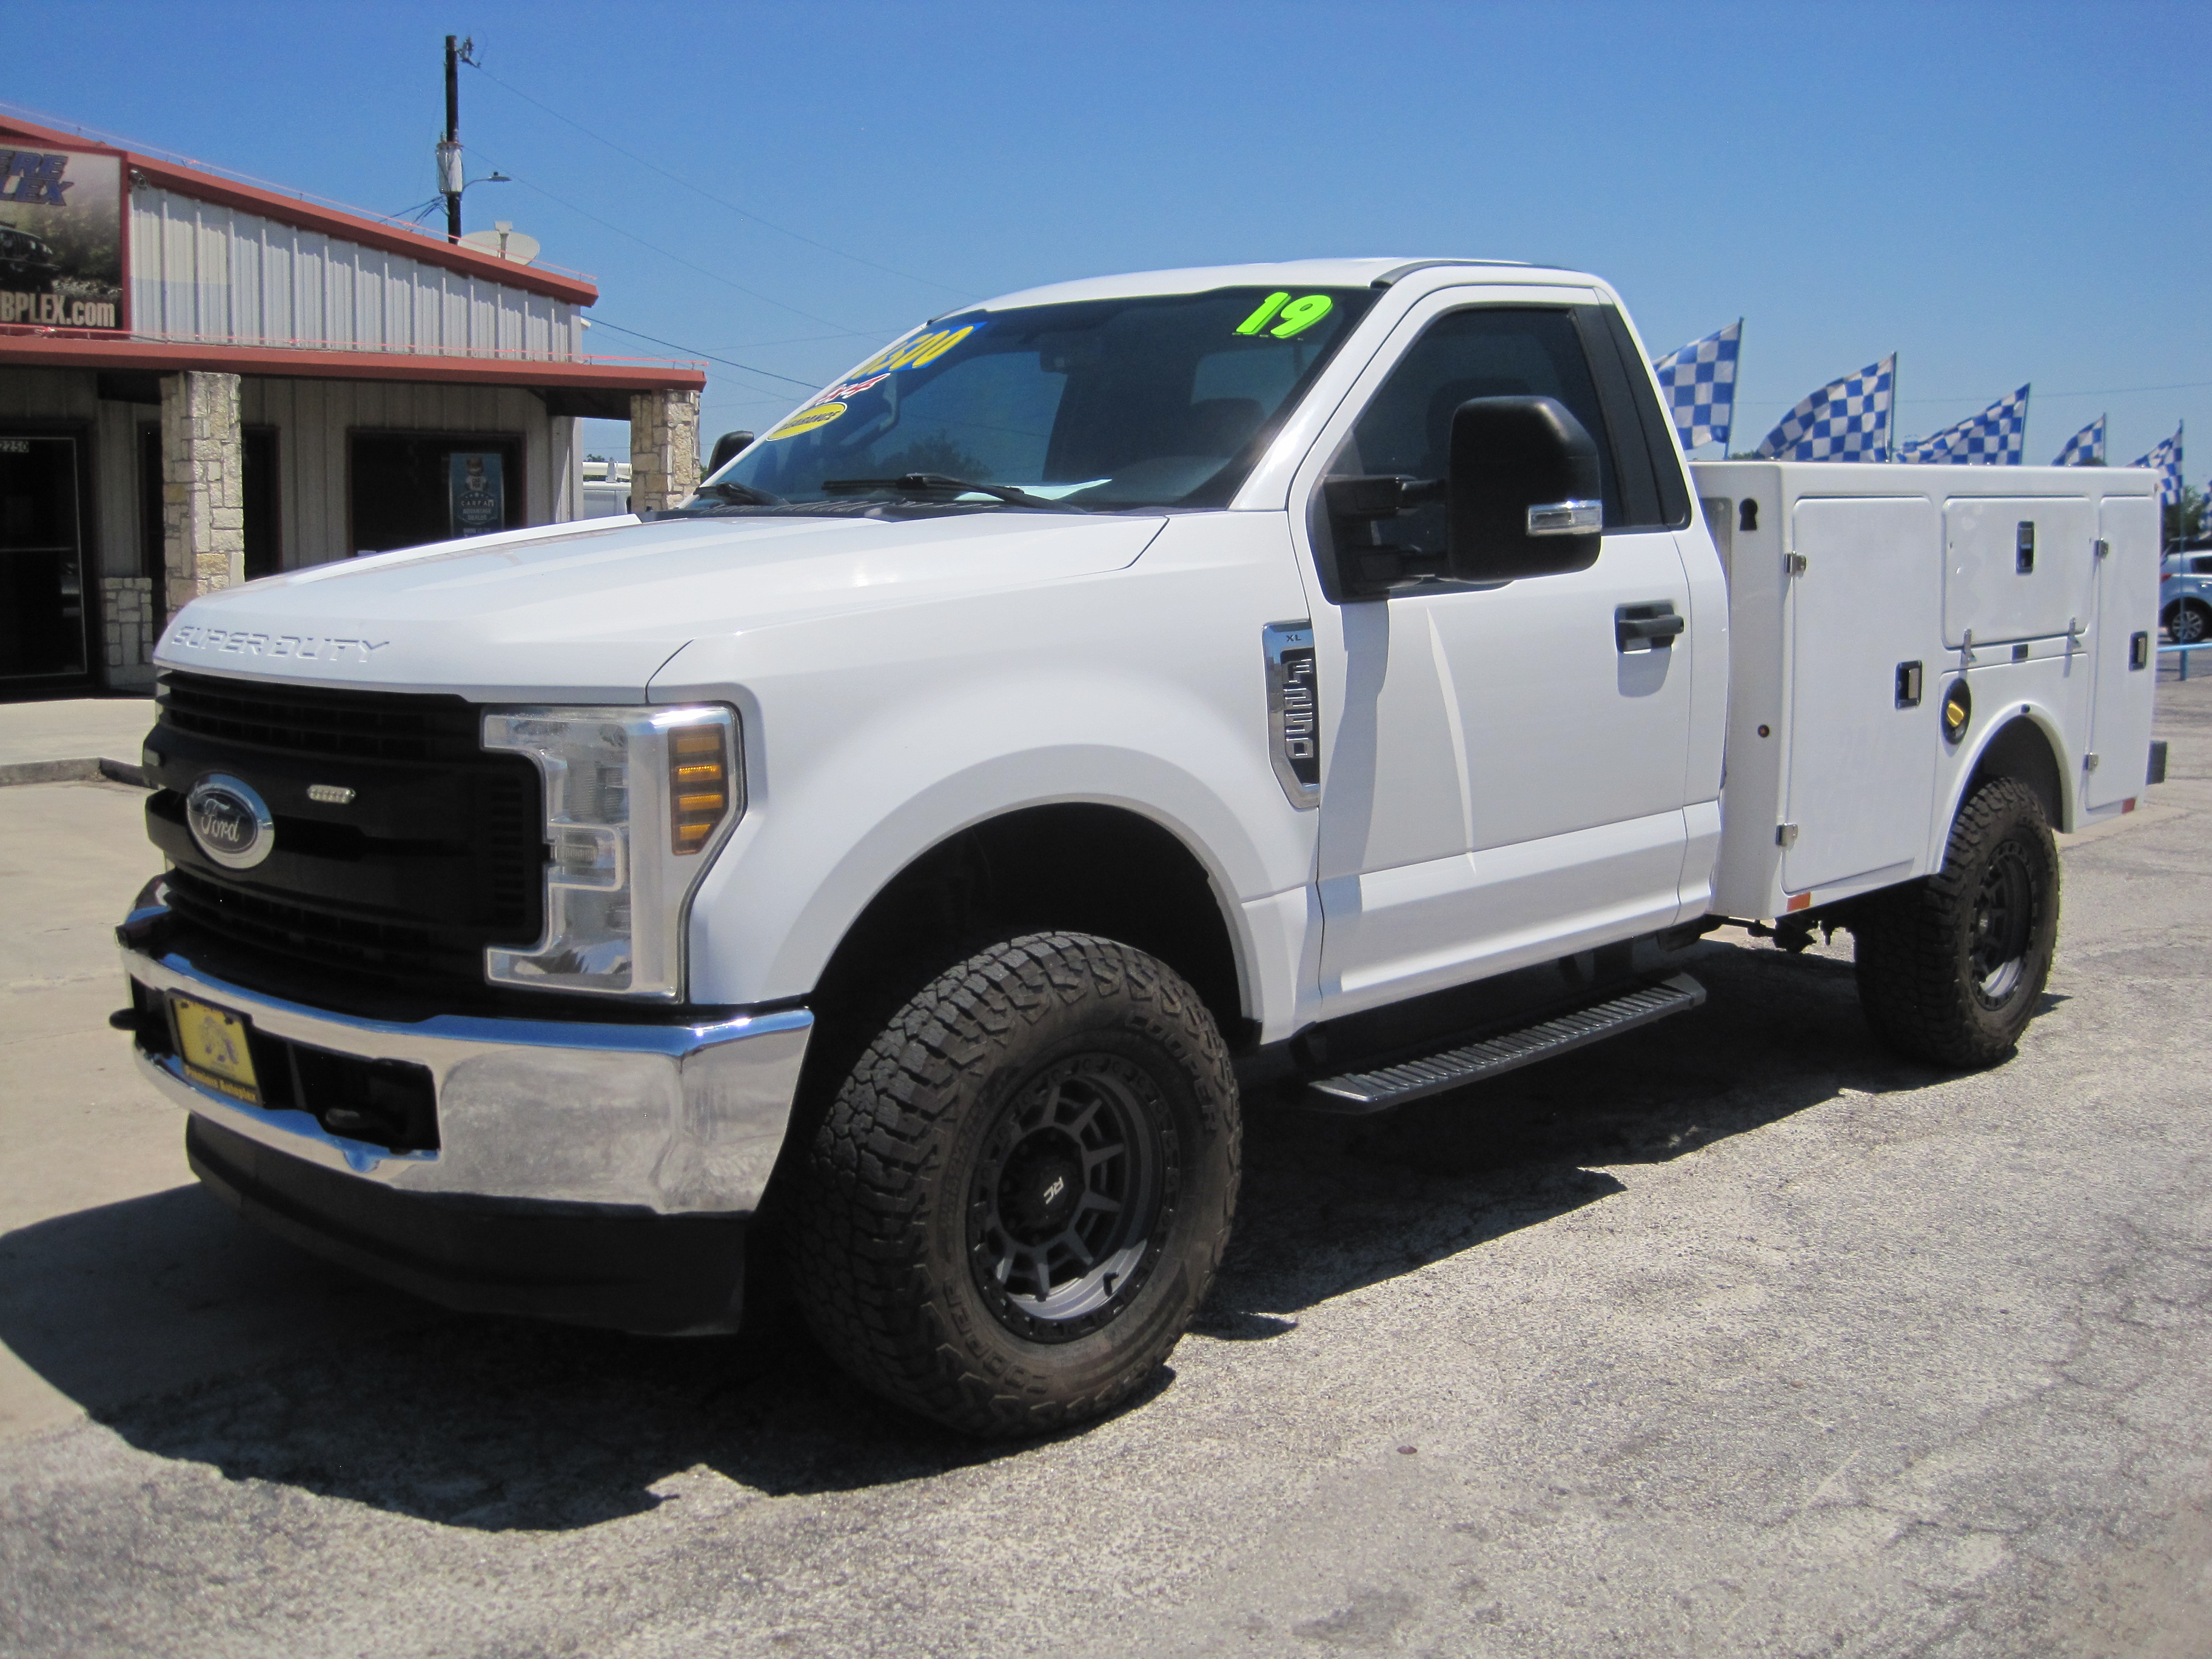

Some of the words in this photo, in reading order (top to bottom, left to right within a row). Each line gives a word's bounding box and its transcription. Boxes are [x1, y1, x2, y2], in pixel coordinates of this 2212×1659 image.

[1235, 291, 1334, 339] 19
[171, 625, 270, 655] SUPER
[266, 634, 389, 663] DUTY
[201, 797, 241, 843] Ford
